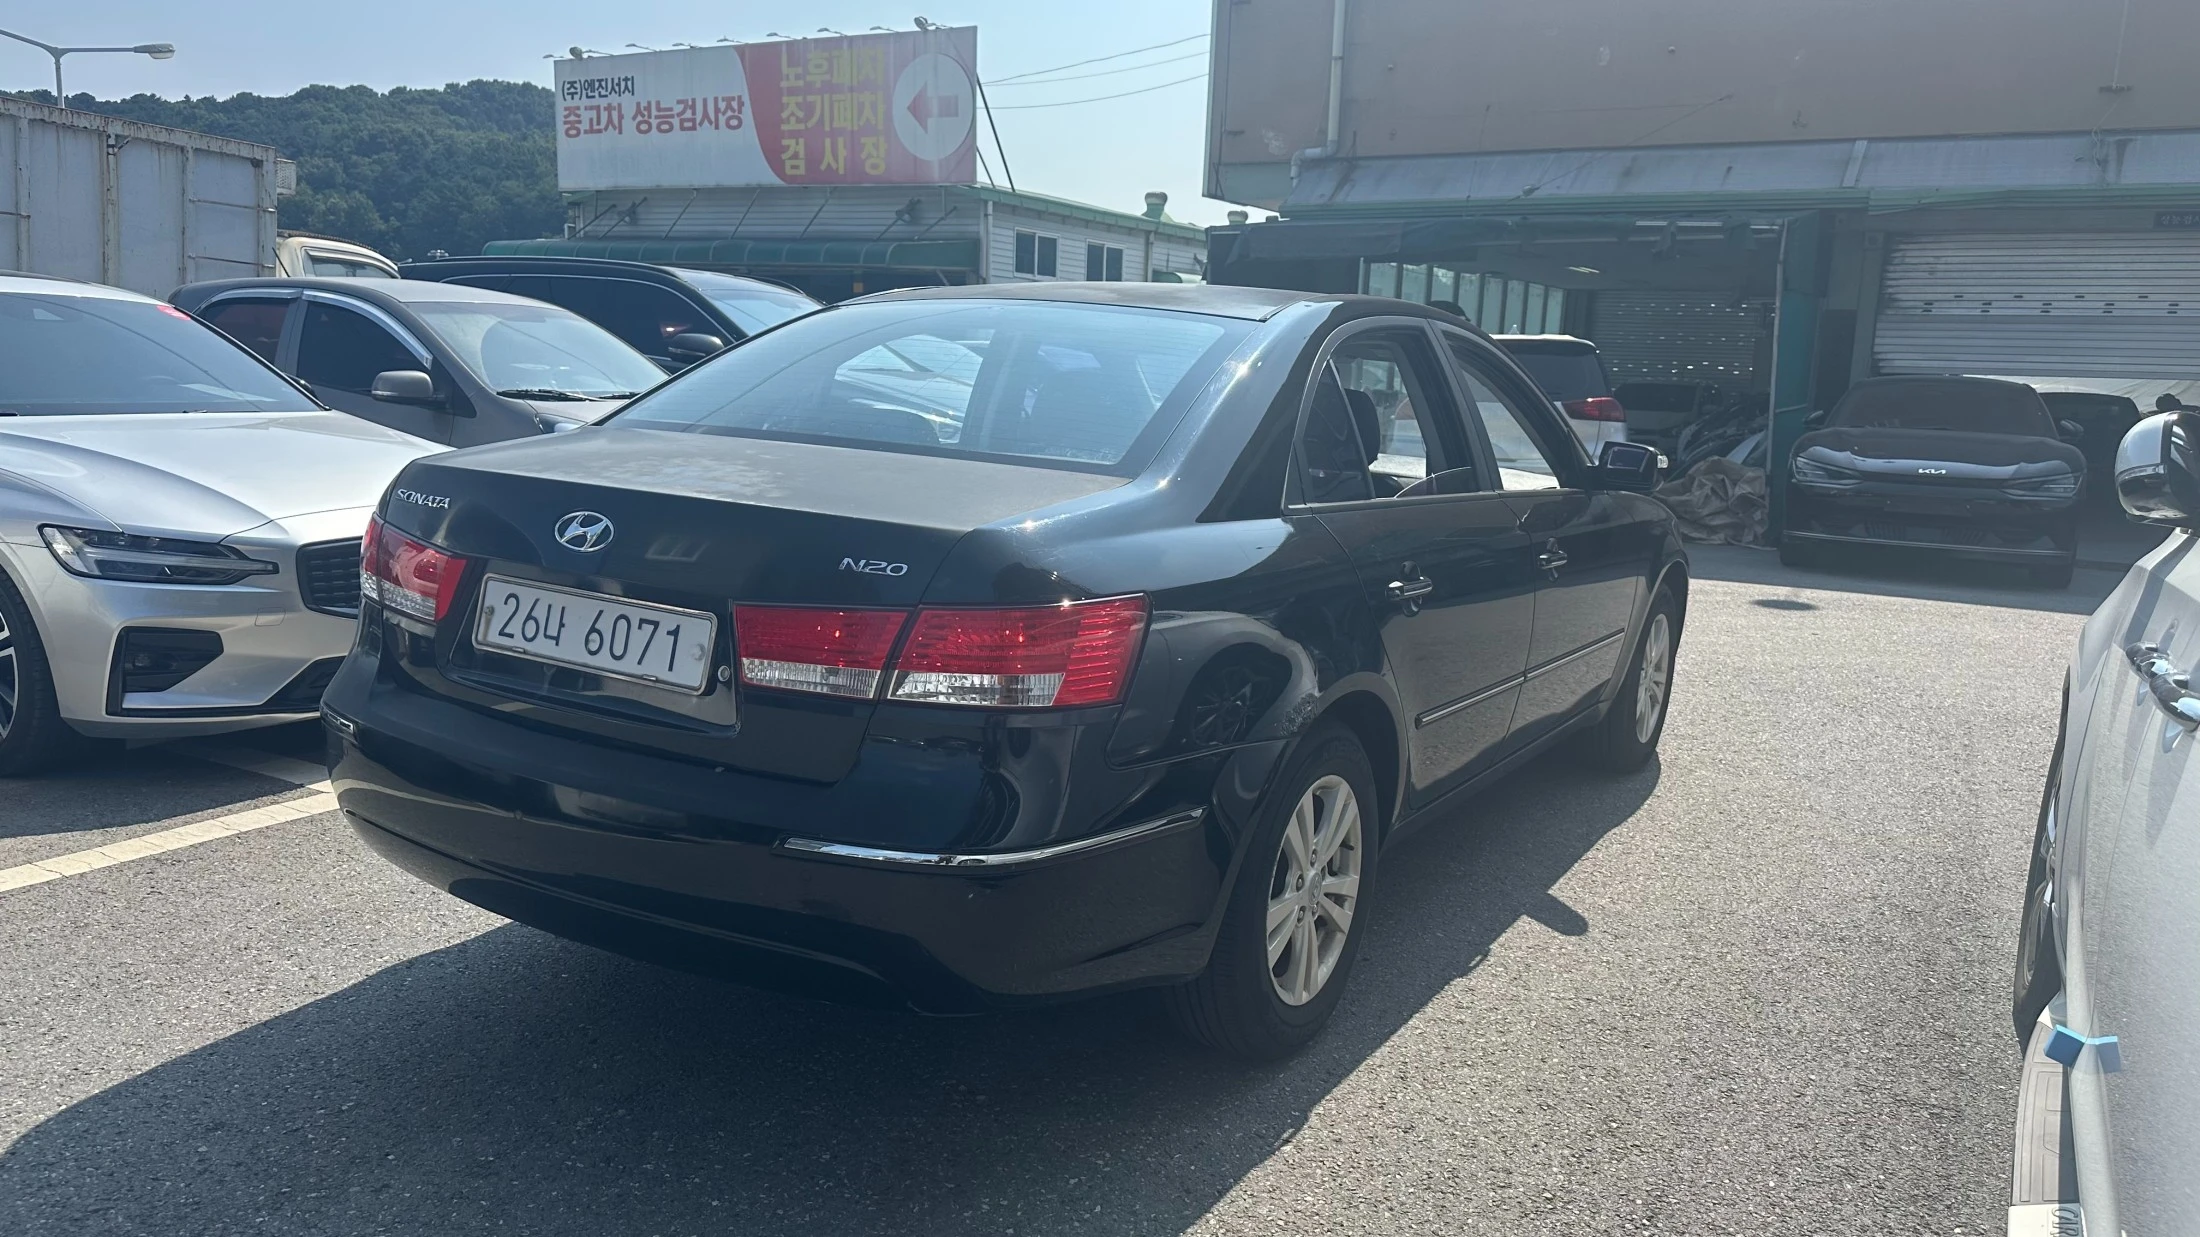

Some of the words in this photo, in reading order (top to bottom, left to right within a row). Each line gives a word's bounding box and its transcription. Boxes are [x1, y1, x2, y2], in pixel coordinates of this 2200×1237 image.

[562, 75, 636, 101] (주)엔진서치
[562, 102, 625, 139] 중고차
[631, 94, 745, 135] 성능검사장
[780, 91, 886, 132] 조기폐차
[395, 488, 451, 510] SONATA
[838, 557, 908, 577] N20
[498, 592, 566, 647] 26나
[584, 609, 681, 672] 6071
